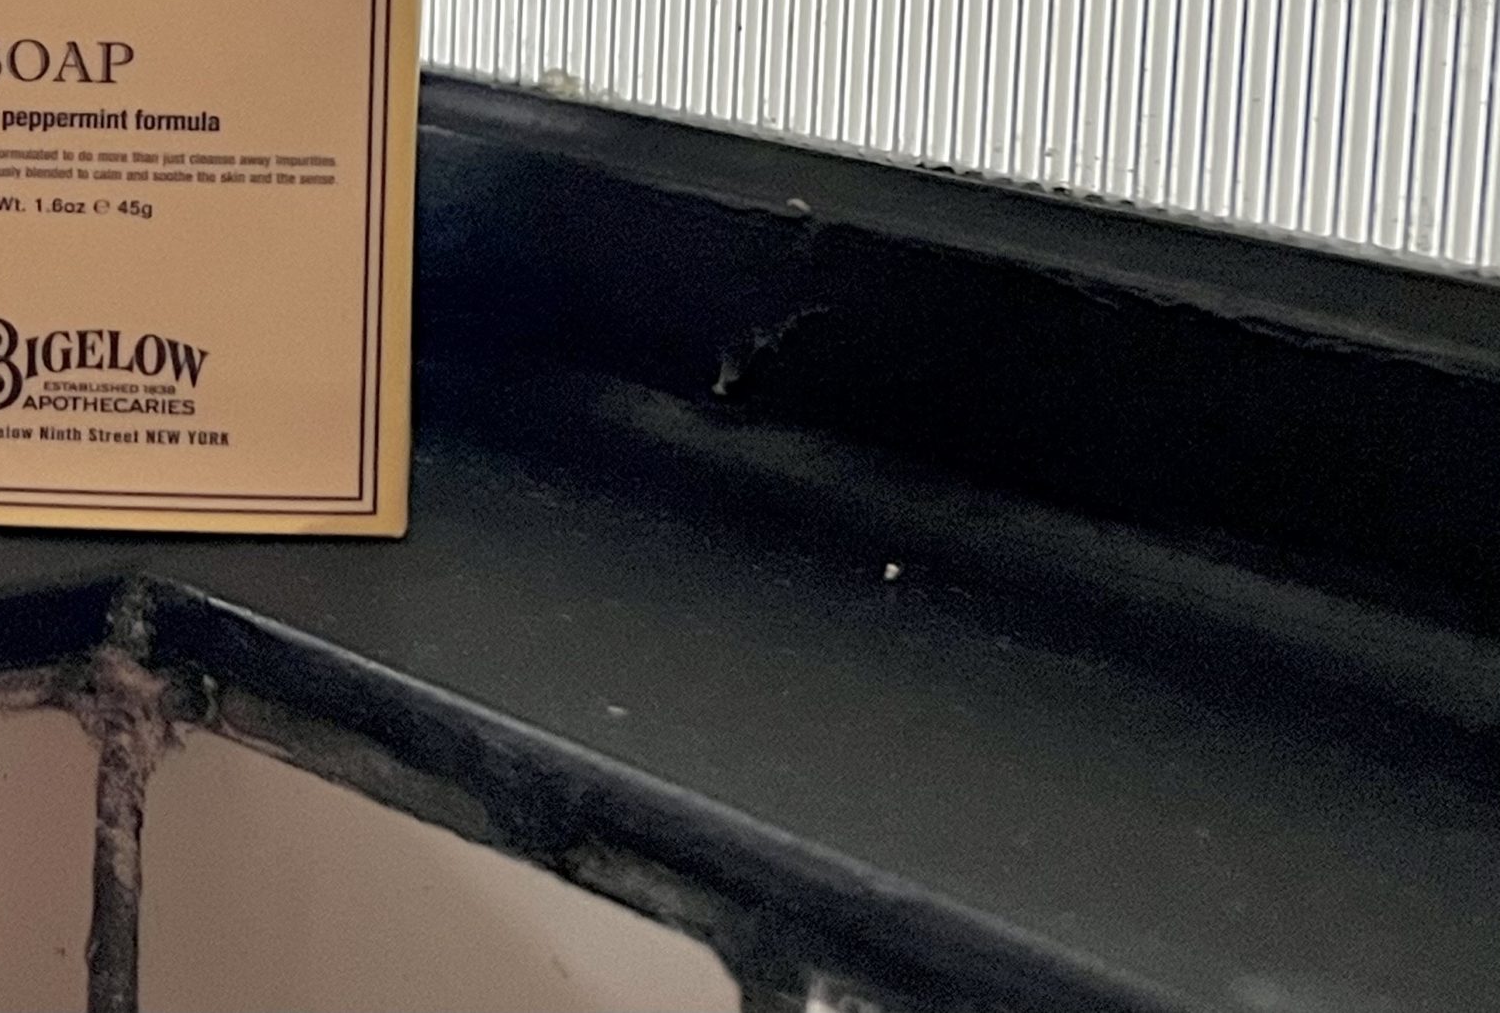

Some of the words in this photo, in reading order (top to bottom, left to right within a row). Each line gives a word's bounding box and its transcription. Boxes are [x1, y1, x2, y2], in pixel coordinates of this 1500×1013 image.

[1, 106, 128, 133] peppermint
[134, 108, 221, 132] formula
[63, 150, 74, 161] to
[78, 150, 93, 162] do
[98, 152, 127, 162] more
[132, 151, 158, 163] than
[163, 153, 185, 166] just
[240, 156, 271, 168] away
[25, 167, 73, 179] blended
[77, 168, 89, 179] to
[93, 169, 122, 180] calm
[126, 170, 149, 181] and
[153, 170, 193, 182] soothe
[197, 171, 216, 183] the
[220, 171, 245, 183] skin
[250, 173, 272, 184] and
[276, 173, 296, 185] the
[35, 197, 86, 214] 1.6oz
[117, 200, 153, 219] 45g
[43, 381, 139, 395] ESTABLISHED
[22, 395, 196, 416] APOTHECARIES
[40, 426, 82, 442] Ninth
[89, 428, 139, 444] Street
[146, 429, 180, 445] NEW
[188, 431, 230, 447] YORK
